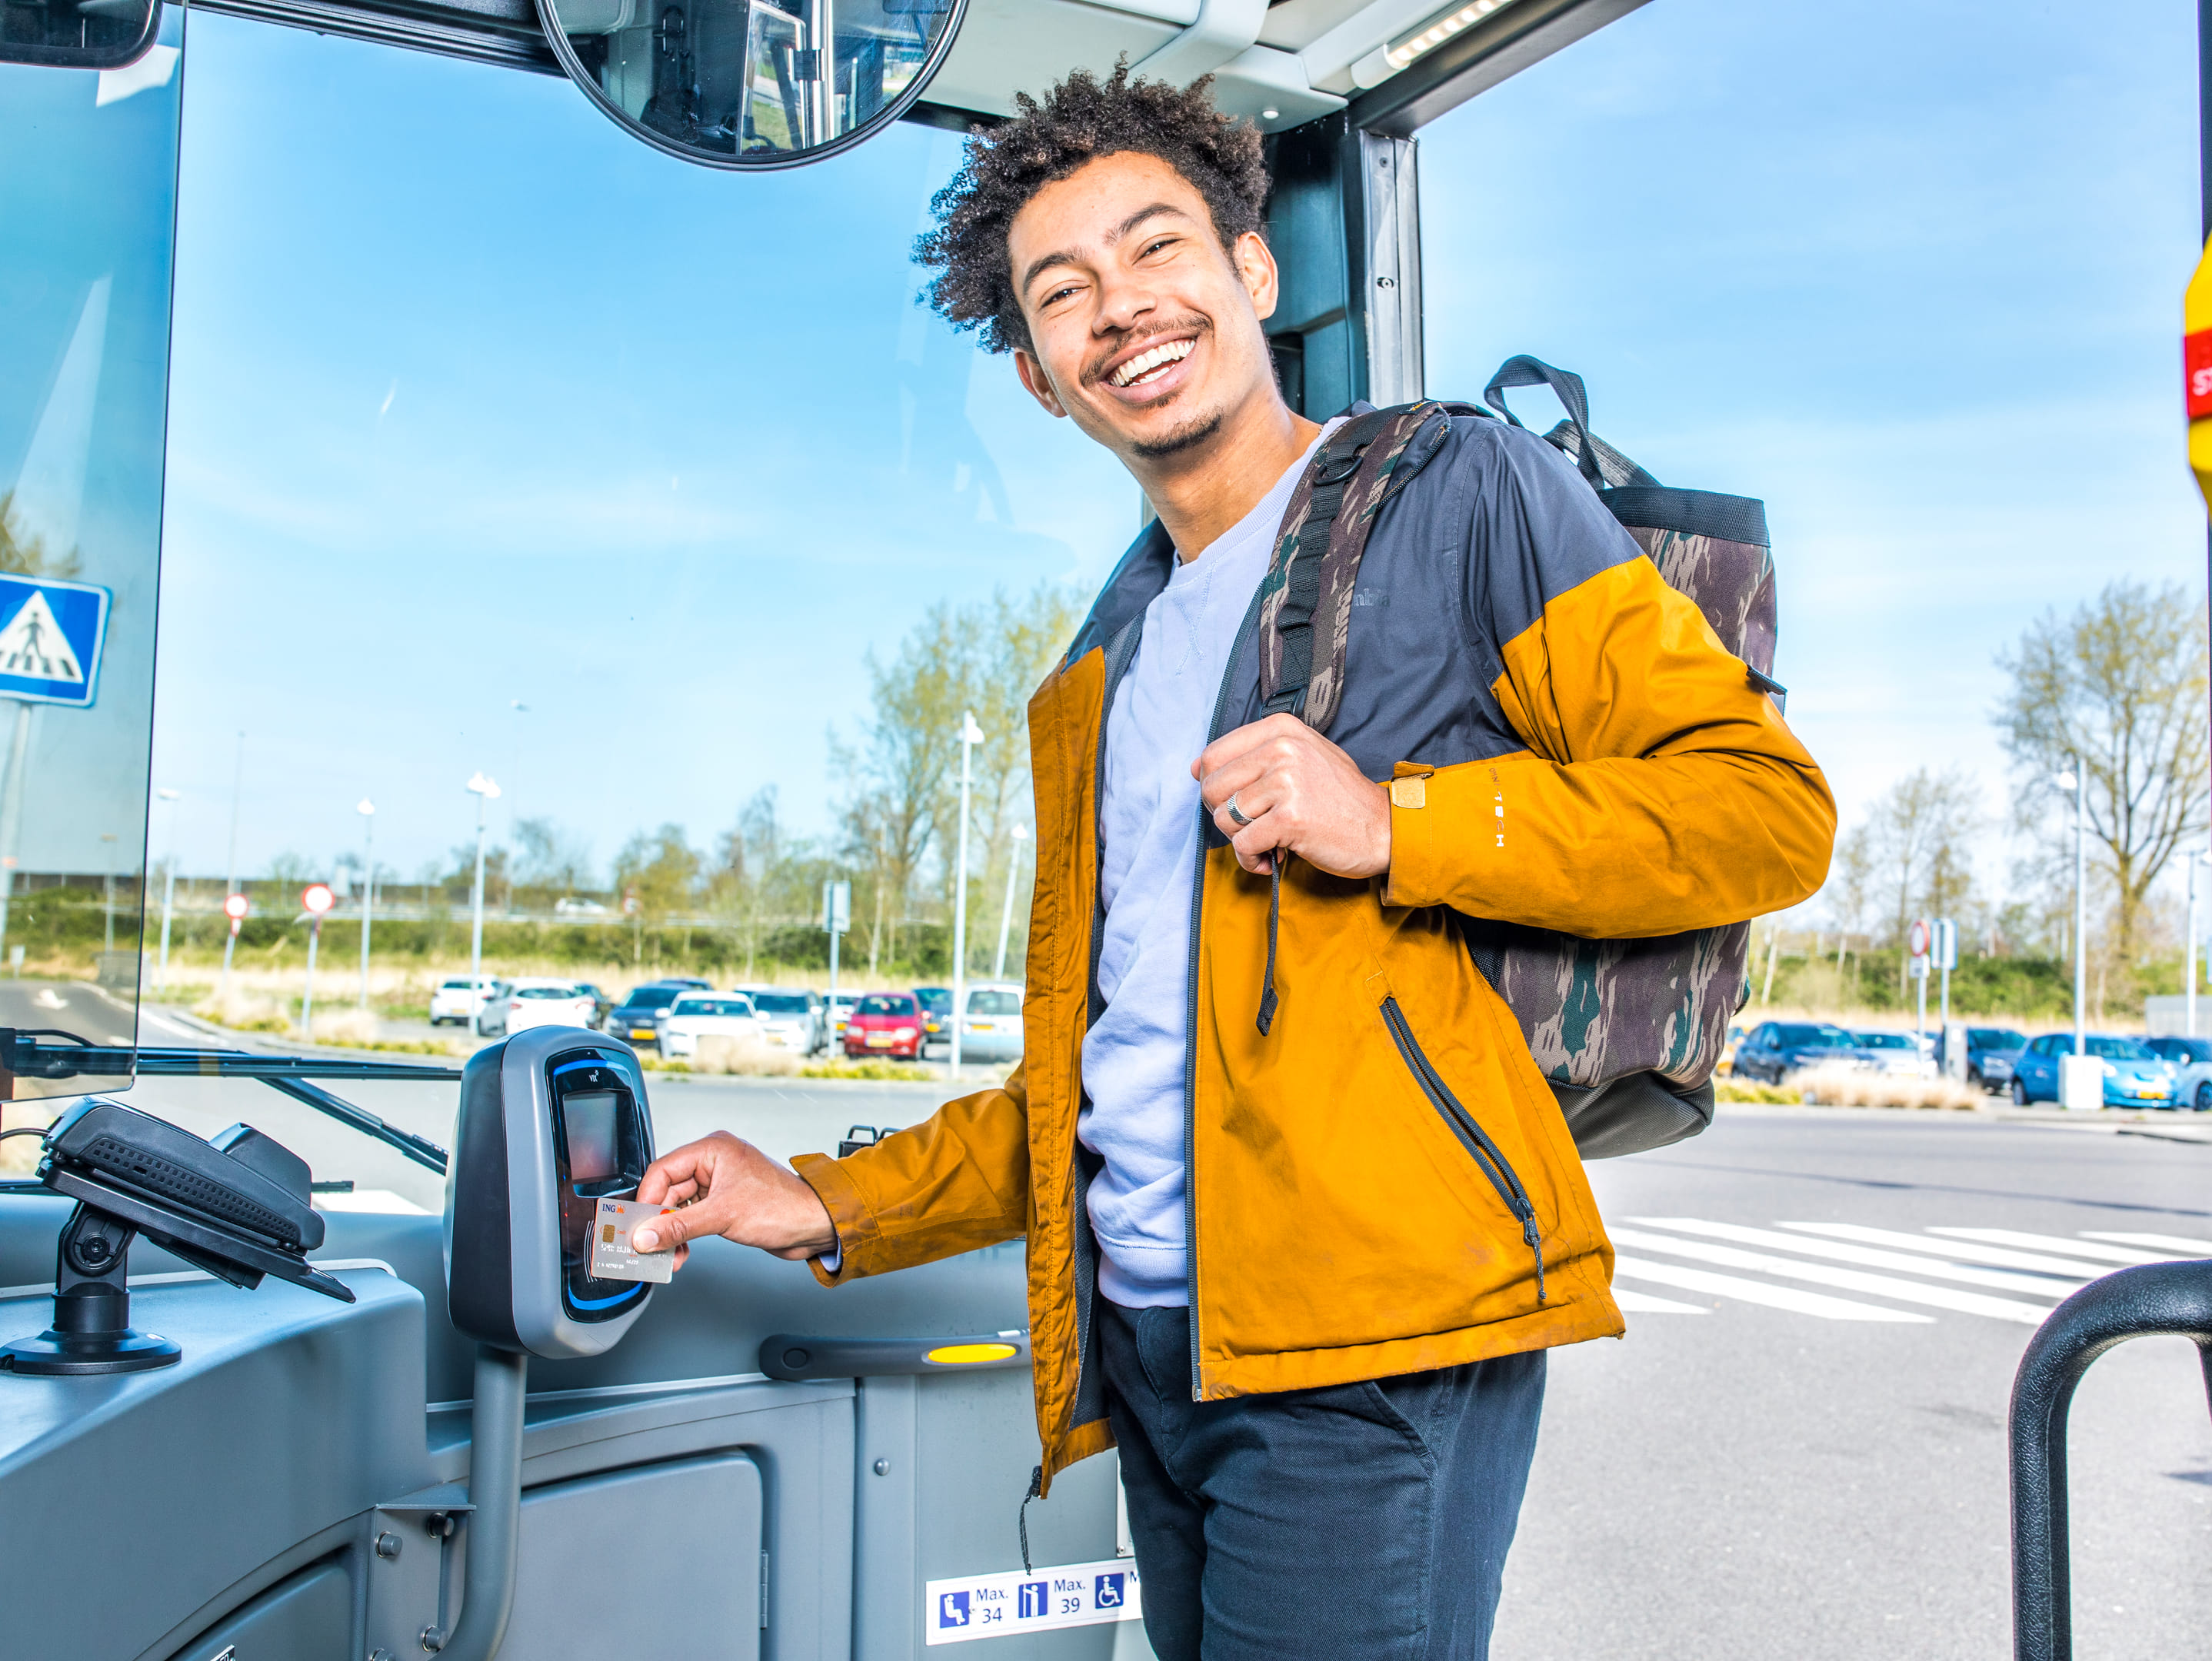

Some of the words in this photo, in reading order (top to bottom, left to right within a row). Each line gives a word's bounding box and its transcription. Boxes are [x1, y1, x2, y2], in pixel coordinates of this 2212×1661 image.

[602, 1203, 616, 1213] ING
[1054, 1579, 1086, 1593] Max.
[977, 1588, 1008, 1602] Max.
[1061, 1597, 1080, 1613] 39
[982, 1607, 1003, 1623] 34
